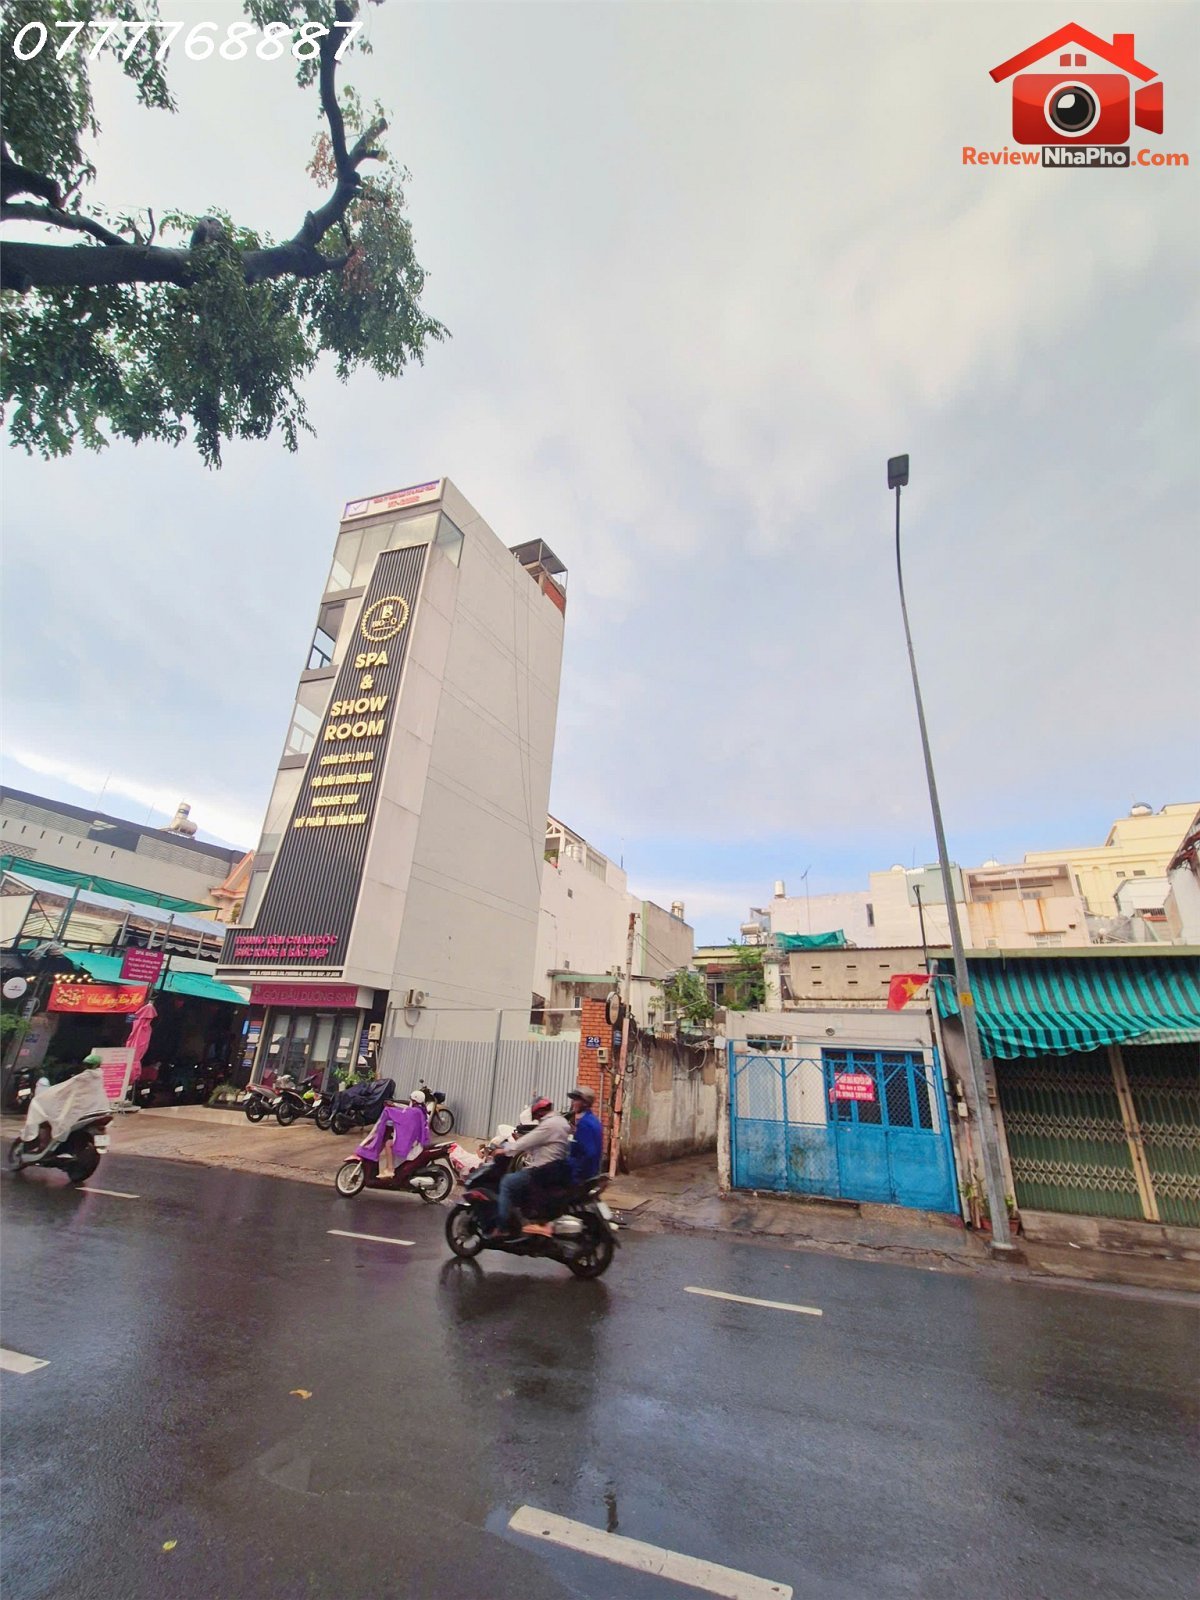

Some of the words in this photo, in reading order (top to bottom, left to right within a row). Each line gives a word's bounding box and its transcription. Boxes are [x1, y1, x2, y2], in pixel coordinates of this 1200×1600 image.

[355, 651, 389, 669] SPA
[360, 674, 374, 690] &
[330, 695, 389, 717] SHOW
[324, 719, 385, 741] ROOM
